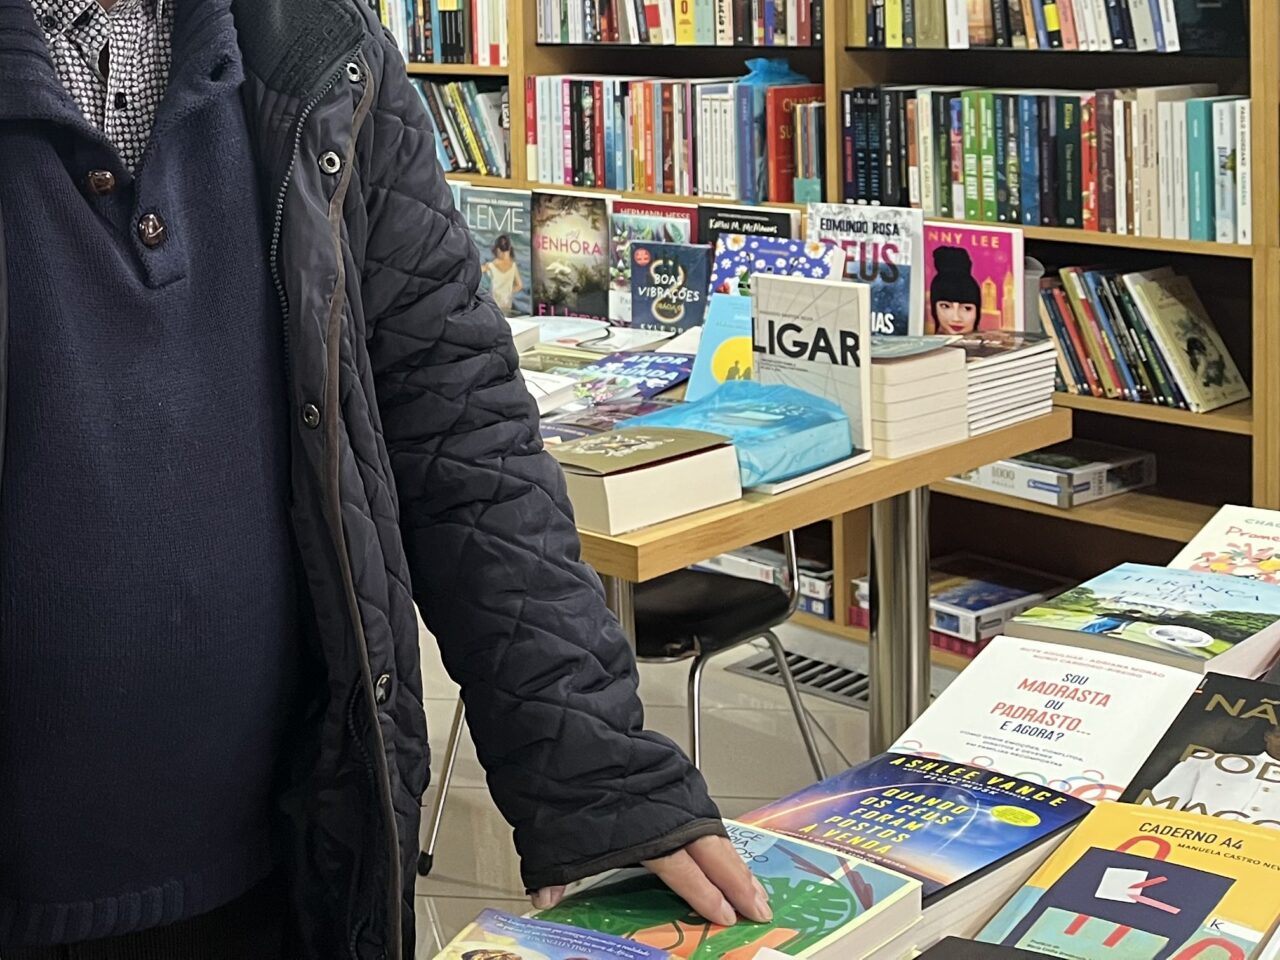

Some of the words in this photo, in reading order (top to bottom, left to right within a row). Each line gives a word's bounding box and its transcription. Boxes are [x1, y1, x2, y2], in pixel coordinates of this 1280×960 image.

[466, 203, 524, 234] LEME
[820, 217, 869, 234] EDMUNDO
[871, 222, 900, 236] ROSA
[532, 233, 603, 256] SENHORA
[927, 230, 964, 246] NNY
[971, 234, 1000, 249] LEE
[654, 272, 682, 287] BOAS
[638, 286, 700, 303] VIBRAÇÕES
[871, 311, 895, 335] IAS
[752, 316, 861, 367] LIGAR
[622, 355, 689, 365] AMOR
[1062, 672, 1090, 685] SOU
[1016, 677, 1112, 708] MADRASTA
[1043, 698, 1065, 711] OU
[999, 720, 1014, 732] E
[1012, 723, 1065, 742] AGORA?
[889, 756, 981, 780] ASHLEE
[986, 776, 1068, 808] VANCE
[960, 782, 1000, 796] MUSK
[859, 796, 892, 810] OS
[881, 788, 970, 815] QUANDO
[824, 815, 911, 843] POSTOS
[849, 806, 923, 832] FORAM
[728, 825, 763, 842] ULCE
[822, 828, 894, 855] VENDA
[1138, 821, 1218, 845] CADERNO
[1220, 836, 1245, 851] A4
[736, 849, 770, 864] OSO
[1176, 842, 1222, 857] MANUELA
[1223, 851, 1263, 868] CASTRO
